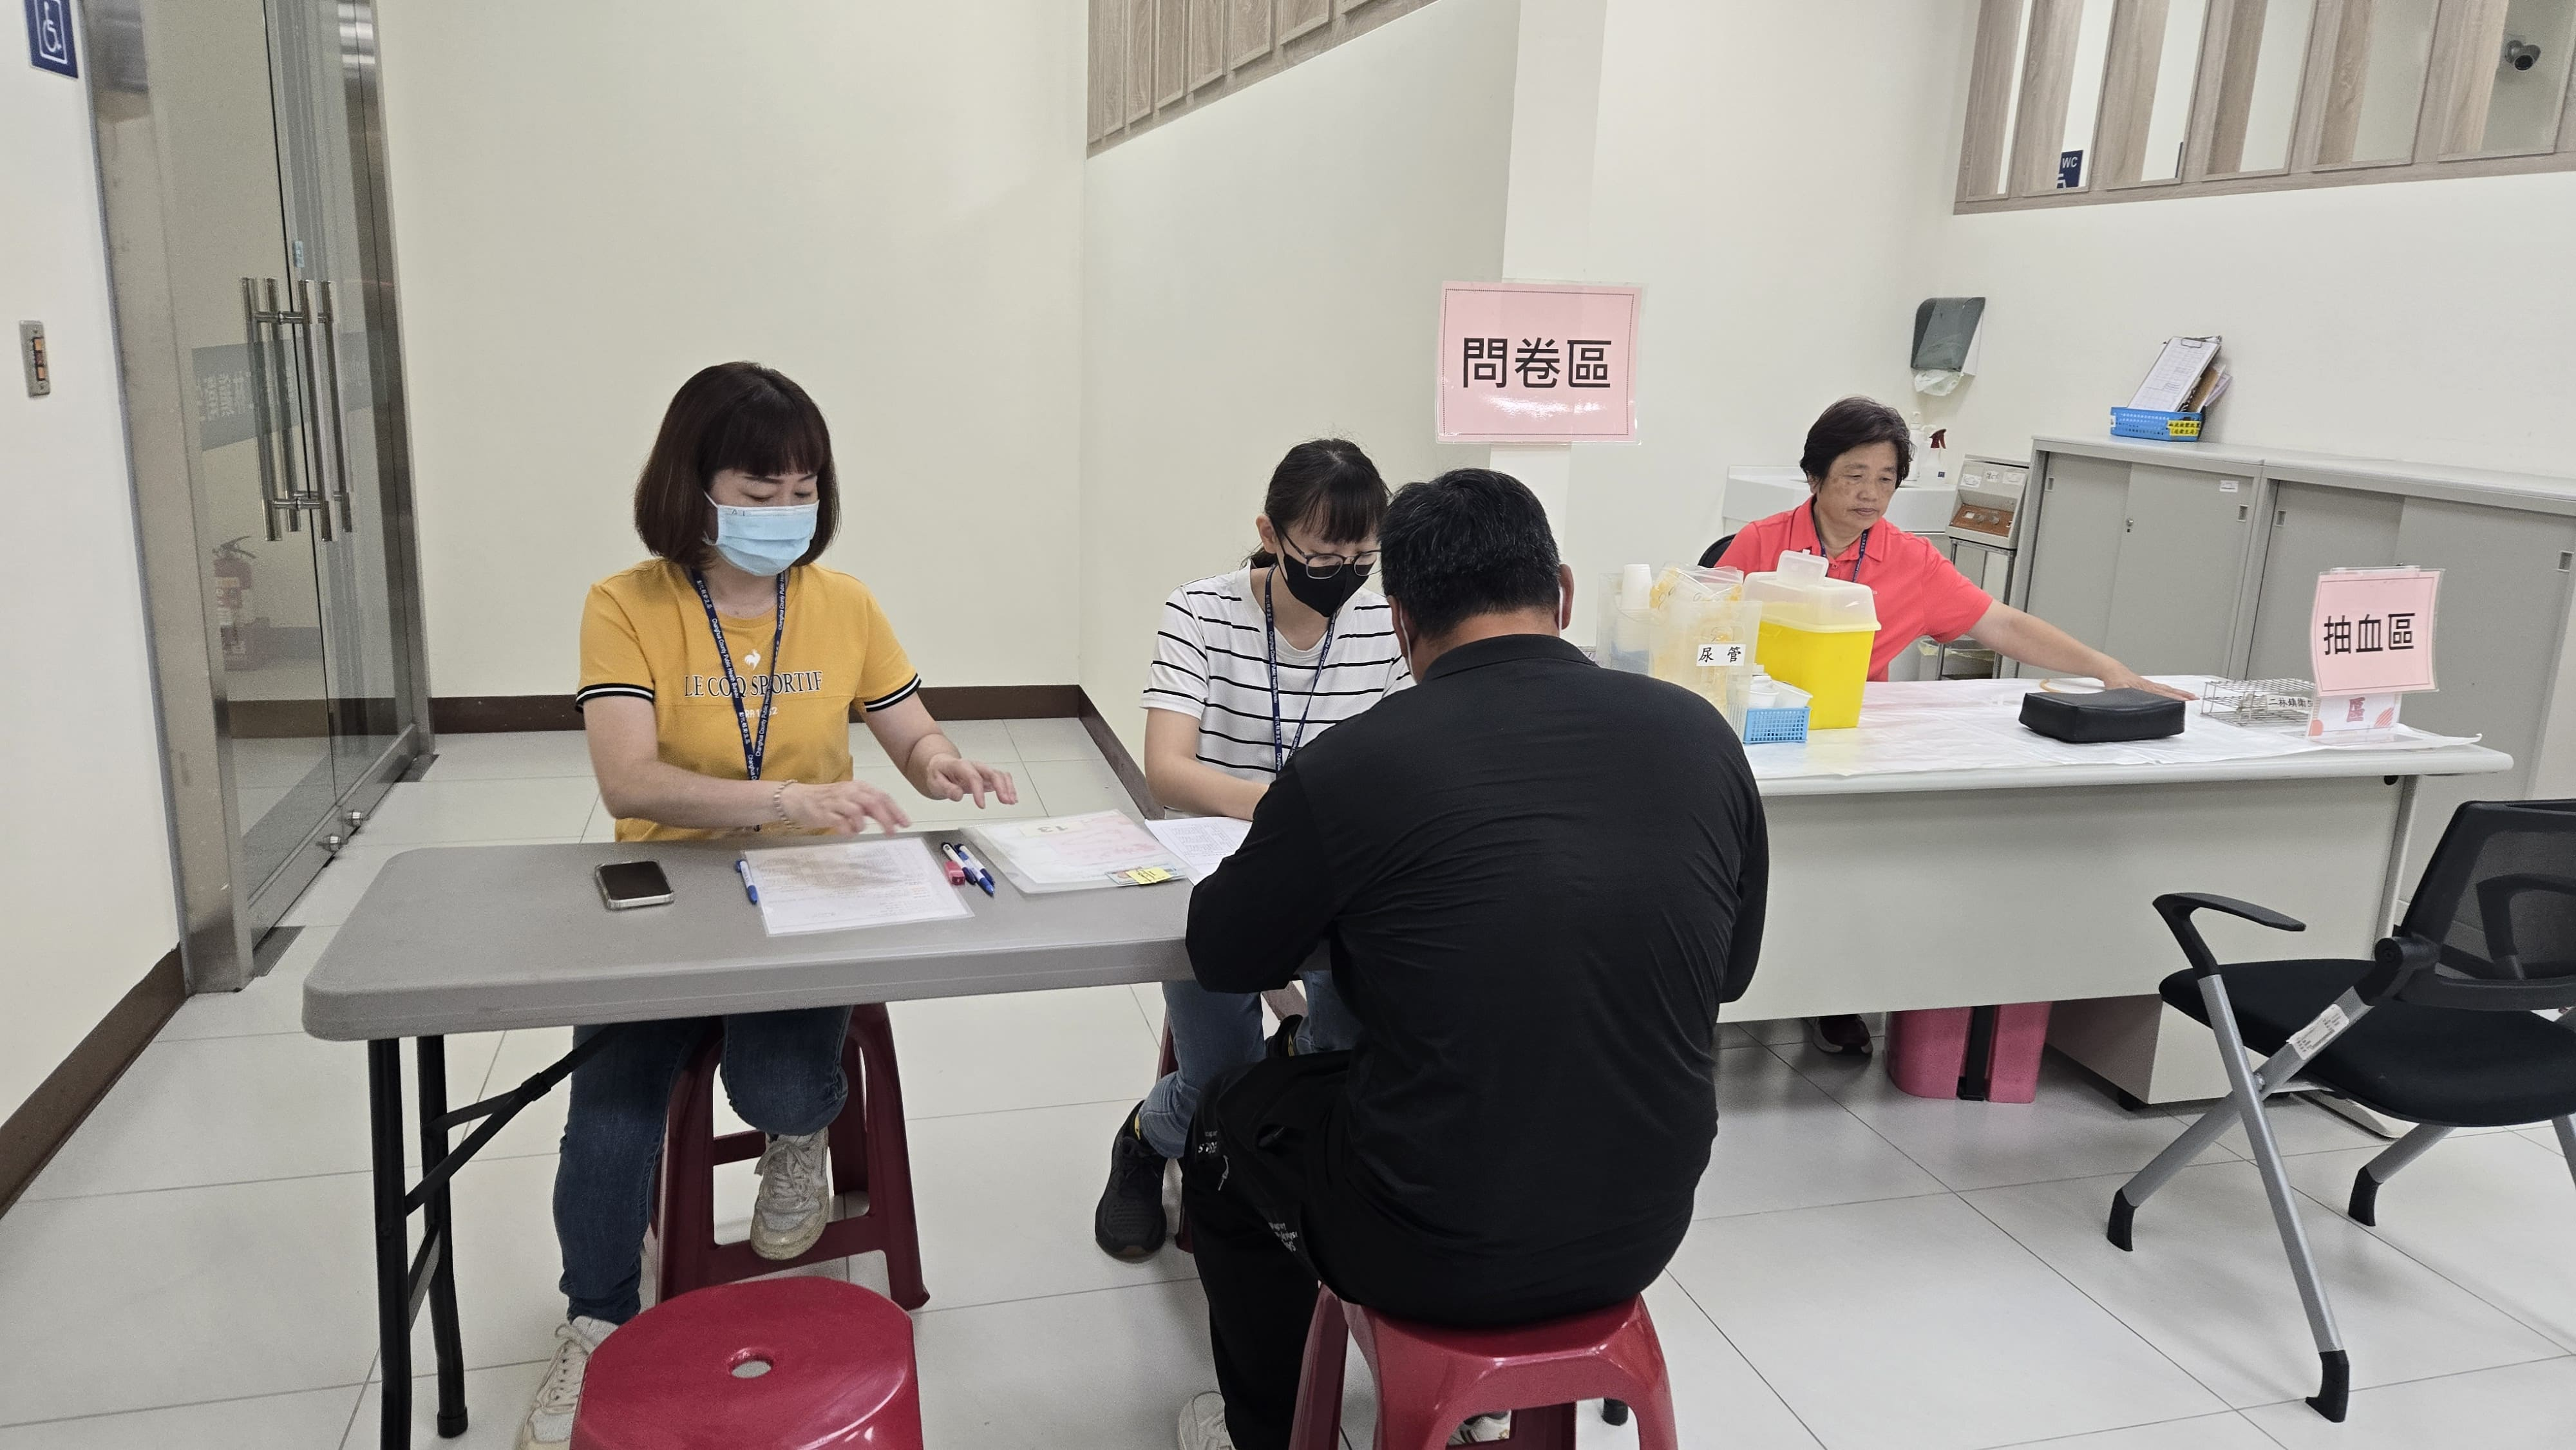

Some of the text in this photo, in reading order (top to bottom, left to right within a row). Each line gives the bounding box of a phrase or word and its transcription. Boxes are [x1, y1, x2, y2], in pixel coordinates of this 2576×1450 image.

[2062, 157, 2078, 168] WC
[1463, 337, 1612, 389] 問卷區
[2324, 612, 2415, 655] 抽血區
[712, 618, 722, 639] Changhua
[718, 639, 727, 654] County
[723, 654, 732, 668] Public
[728, 668, 736, 683] Health
[1698, 646, 1741, 663] 尿管
[685, 675, 704, 697] LE
[707, 675, 746, 698] COQ
[750, 670, 823, 696] SPORTIF
[744, 709, 755, 718] RA
[759, 719, 767, 734] County
[755, 735, 764, 757] Changhua
